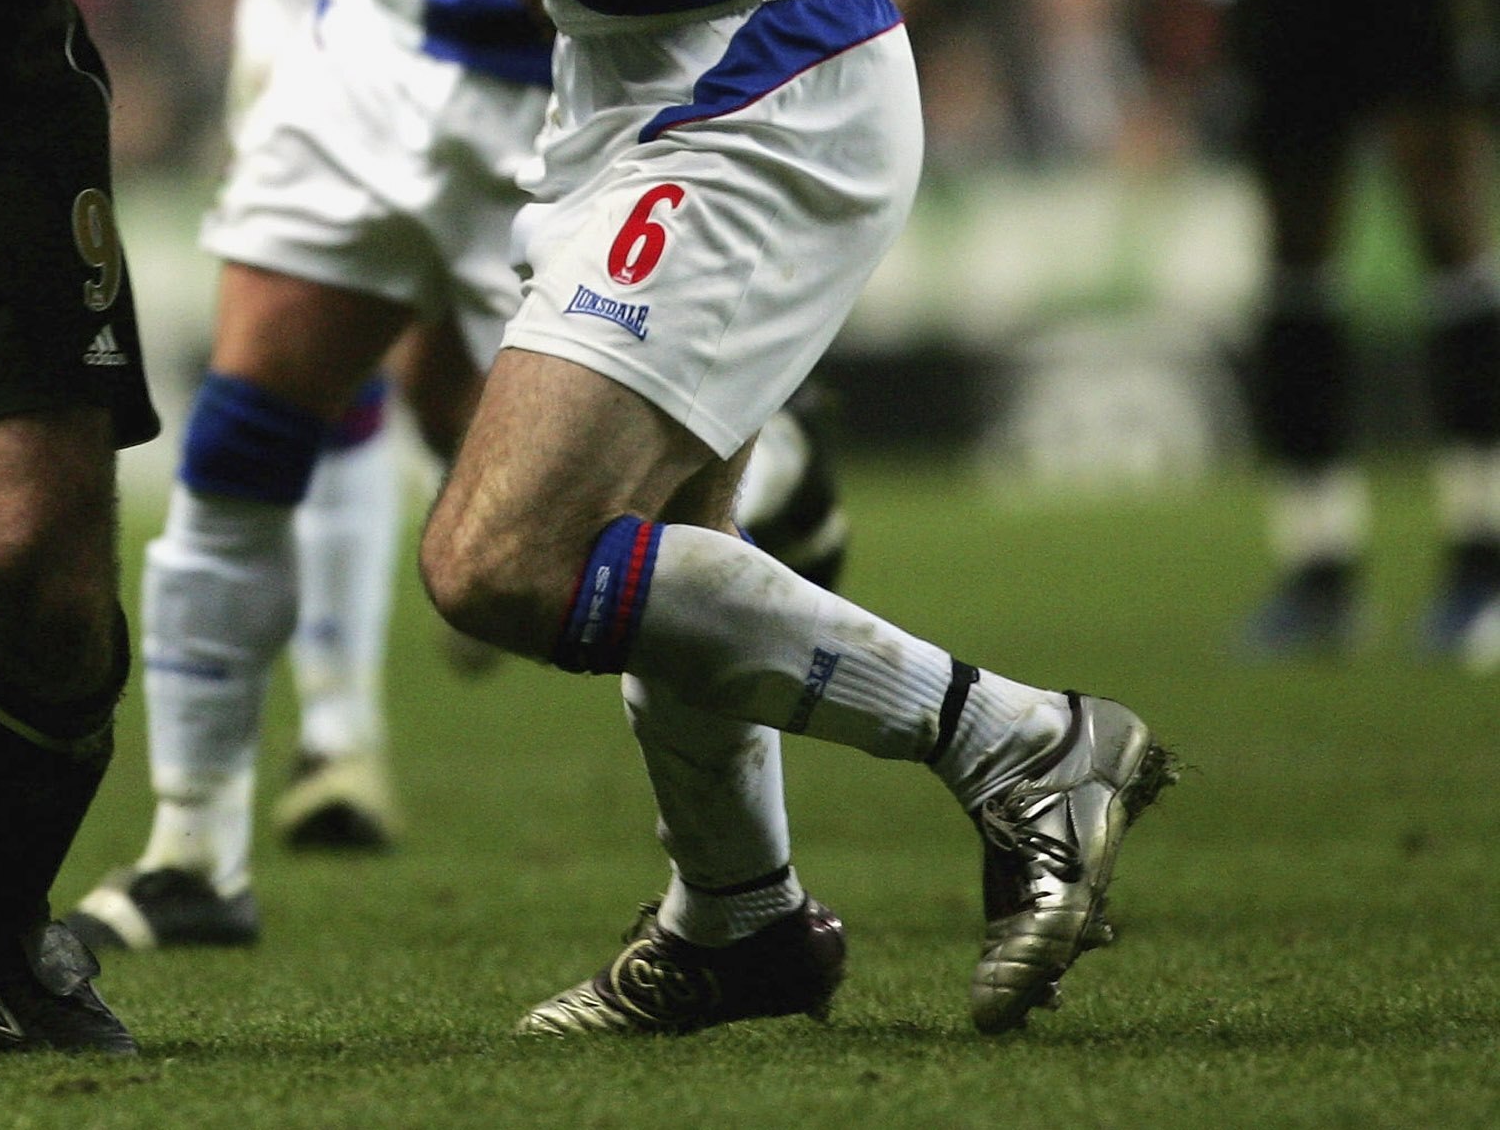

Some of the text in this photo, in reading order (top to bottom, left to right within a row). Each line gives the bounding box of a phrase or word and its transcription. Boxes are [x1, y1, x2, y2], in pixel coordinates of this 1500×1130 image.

[71, 187, 123, 313] 9
[606, 182, 686, 286] 6
[563, 284, 651, 342] LONSDALE
